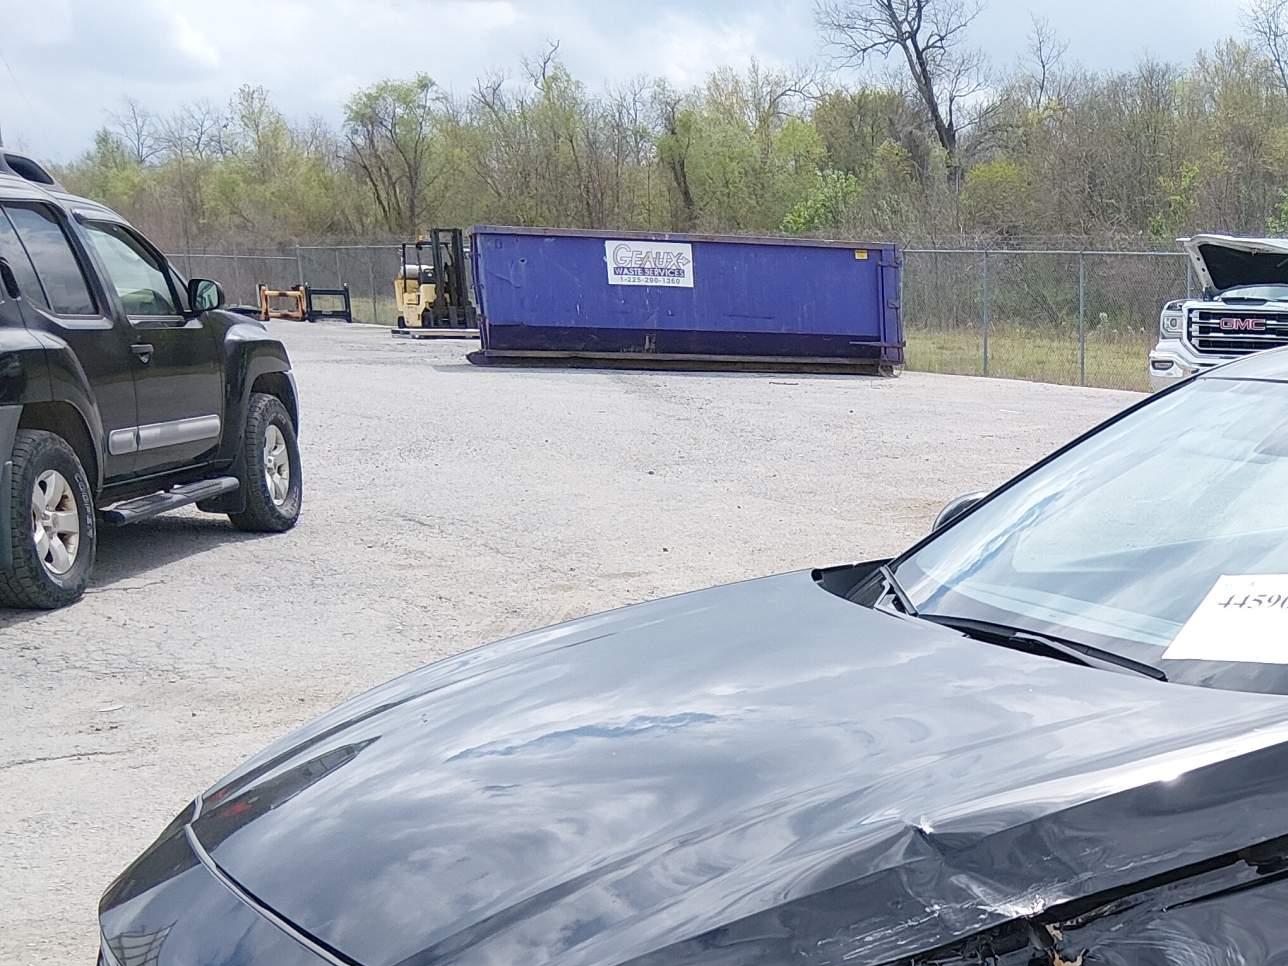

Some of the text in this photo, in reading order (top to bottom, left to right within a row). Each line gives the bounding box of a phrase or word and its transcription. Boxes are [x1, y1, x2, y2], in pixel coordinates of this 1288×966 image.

[612, 243, 683, 269] GEAUX
[614, 267, 684, 278] WASTE SERVICES
[1219, 317, 1266, 331] GMC
